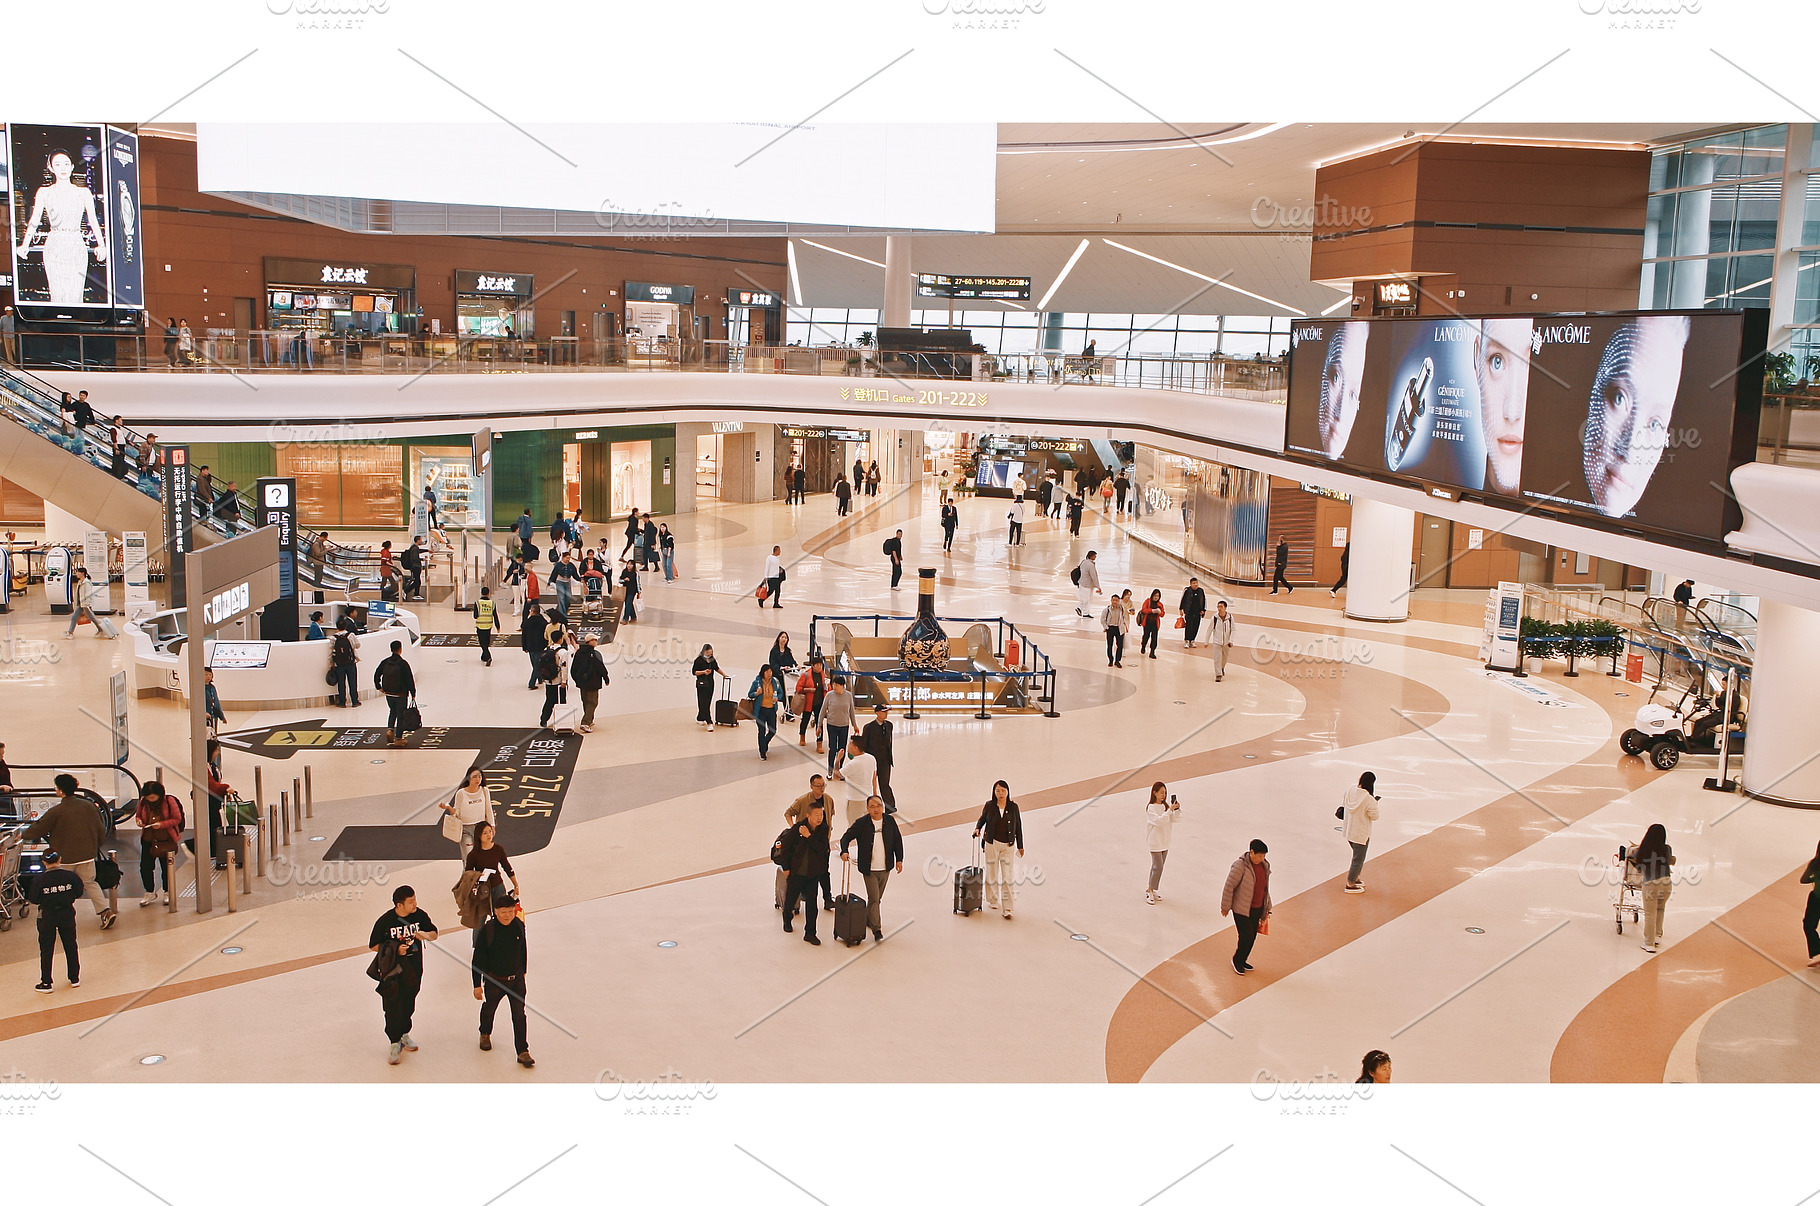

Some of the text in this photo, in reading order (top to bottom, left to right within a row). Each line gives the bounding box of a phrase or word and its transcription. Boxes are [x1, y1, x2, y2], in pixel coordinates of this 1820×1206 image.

[650, 286, 672, 295] GODIVA
[1434, 323, 1473, 342] LANCÔM
[854, 388, 977, 407] 登机口 Gates 201-222
[711, 421, 743, 432] VALENTINO
[793, 429, 819, 438] 201-222
[1038, 441, 1070, 451] 201-222
[280, 511, 291, 546] Enquiry
[887, 686, 931, 702] 青花郎
[494, 745, 519, 762] Gates
[506, 739, 565, 818] 登机口 27-45
[389, 922, 421, 939] PEACE
